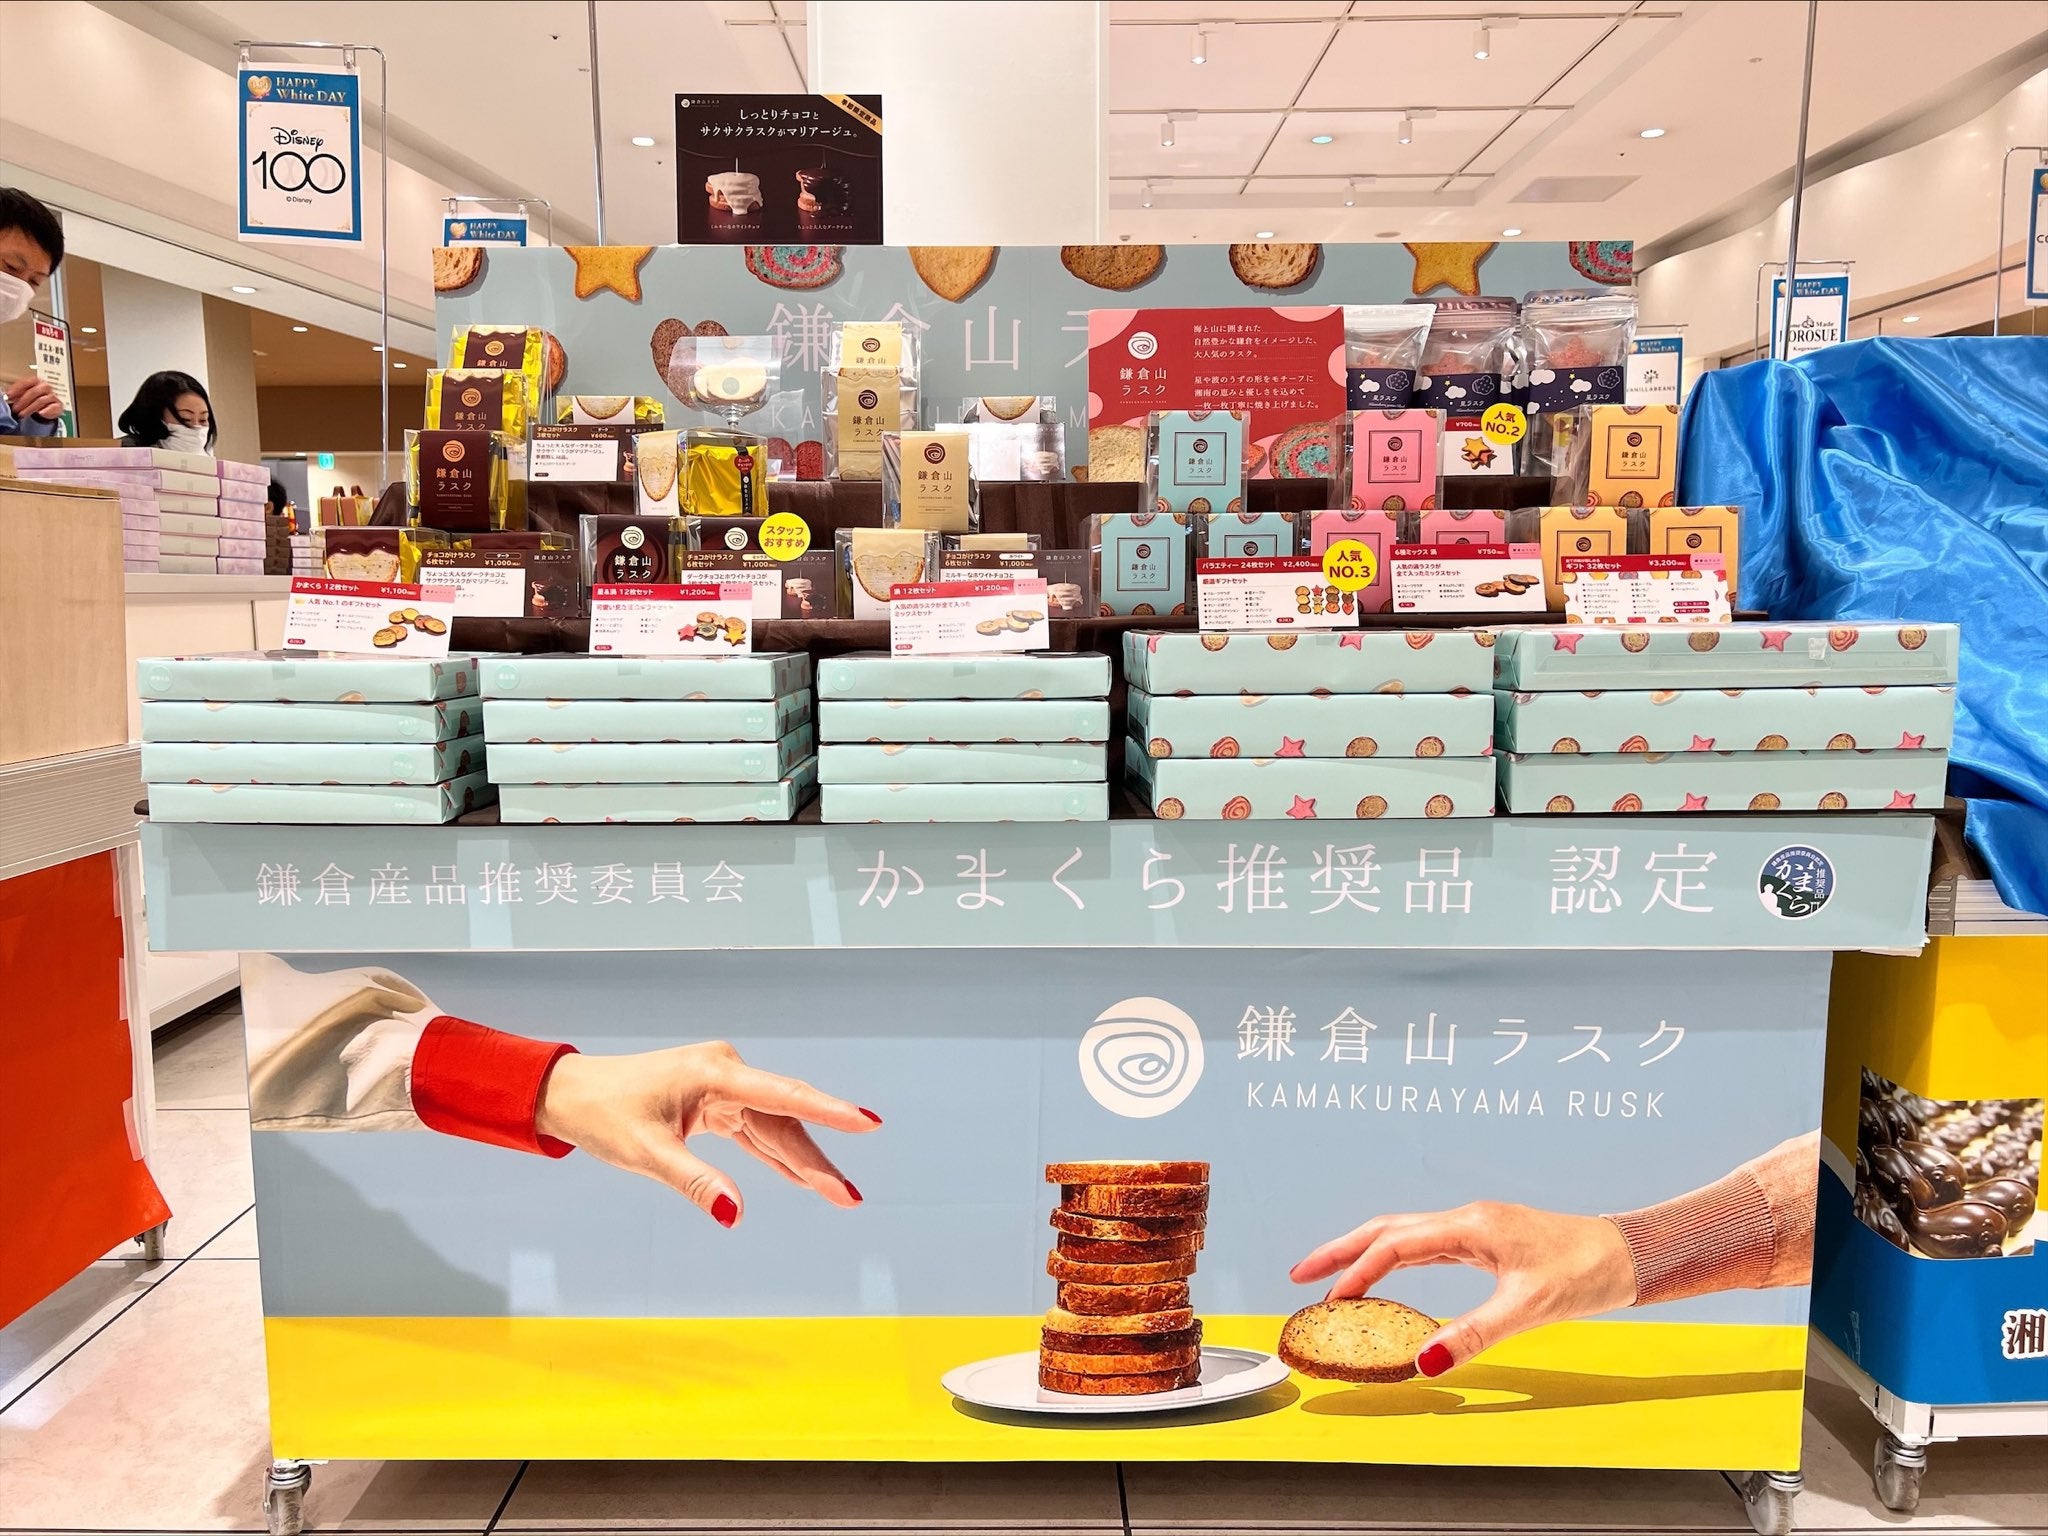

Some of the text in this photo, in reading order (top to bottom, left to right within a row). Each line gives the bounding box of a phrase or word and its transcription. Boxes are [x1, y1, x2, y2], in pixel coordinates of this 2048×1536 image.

[276, 77, 318, 88] HAPPY
[276, 88, 347, 103] White DAY
[740, 108, 819, 121] しっとりチョコと
[700, 125, 858, 138] サクサクラスクがマリアージュ。
[270, 126, 324, 152] Disney
[252, 150, 346, 194] 100
[469, 230, 518, 239] White DAY
[1796, 287, 1840, 296] White DAY
[1193, 324, 1261, 334] 海と山に囲まれた
[1194, 336, 1318, 346] 自然豊かな鎌倉をイメージした、
[1193, 349, 1260, 359] 大人気のラスク。
[476, 359, 509, 367] 鎌倉山
[1119, 367, 1168, 380] 鎌倉山
[1194, 374, 1314, 384] 星や波のうずの形をモチーフに
[1121, 384, 1167, 396] ラスク
[1194, 387, 1306, 397] 湘南の恵みと優しさを込めて
[1194, 400, 1321, 410] 一枚一枚丁寧に焼き上げました。
[454, 411, 487, 421] 鎌倉山
[852, 415, 885, 425] 鎌倉山
[1494, 411, 1516, 423] 人気
[1485, 417, 1520, 437] NO.2
[1382, 455, 1408, 463] 鎌倉山
[1621, 451, 1647, 459] 鎌倉山
[436, 467, 472, 478] 鎌倉山
[918, 470, 952, 480] 鎌倉山
[438, 481, 472, 491] ラスク
[920, 484, 952, 493] ラスク
[766, 525, 804, 535] スタッフ
[764, 538, 805, 548] おすすめ
[614, 555, 652, 566] 鎌倉山
[1337, 550, 1362, 562] 人気
[1131, 563, 1156, 571] 鎌倉山
[1241, 561, 1275, 569] 24枚セット
[1283, 560, 1310, 568] ¥2,400
[1648, 559, 1677, 567] ¥3,200
[616, 569, 651, 579] ラスク
[1329, 565, 1371, 578] NO.3
[295, 580, 360, 592] かまくら 12枚セット
[380, 586, 408, 595] ¥1,100
[902, 586, 937, 595] 12枚セット
[619, 588, 654, 596] 12枚セット
[679, 588, 707, 597] ¥1,200
[341, 600, 382, 609] のギフトセット
[255, 859, 746, 908] 鎌倉産品推奨委員会
[857, 842, 1719, 916] かまくら推奨品 認定
[1815, 868, 1826, 899] 推奨品
[1236, 1004, 1686, 1067] 鎌倉山ラスク
[1247, 1081, 1665, 1119] KAMAKURAYAMA RUSK
